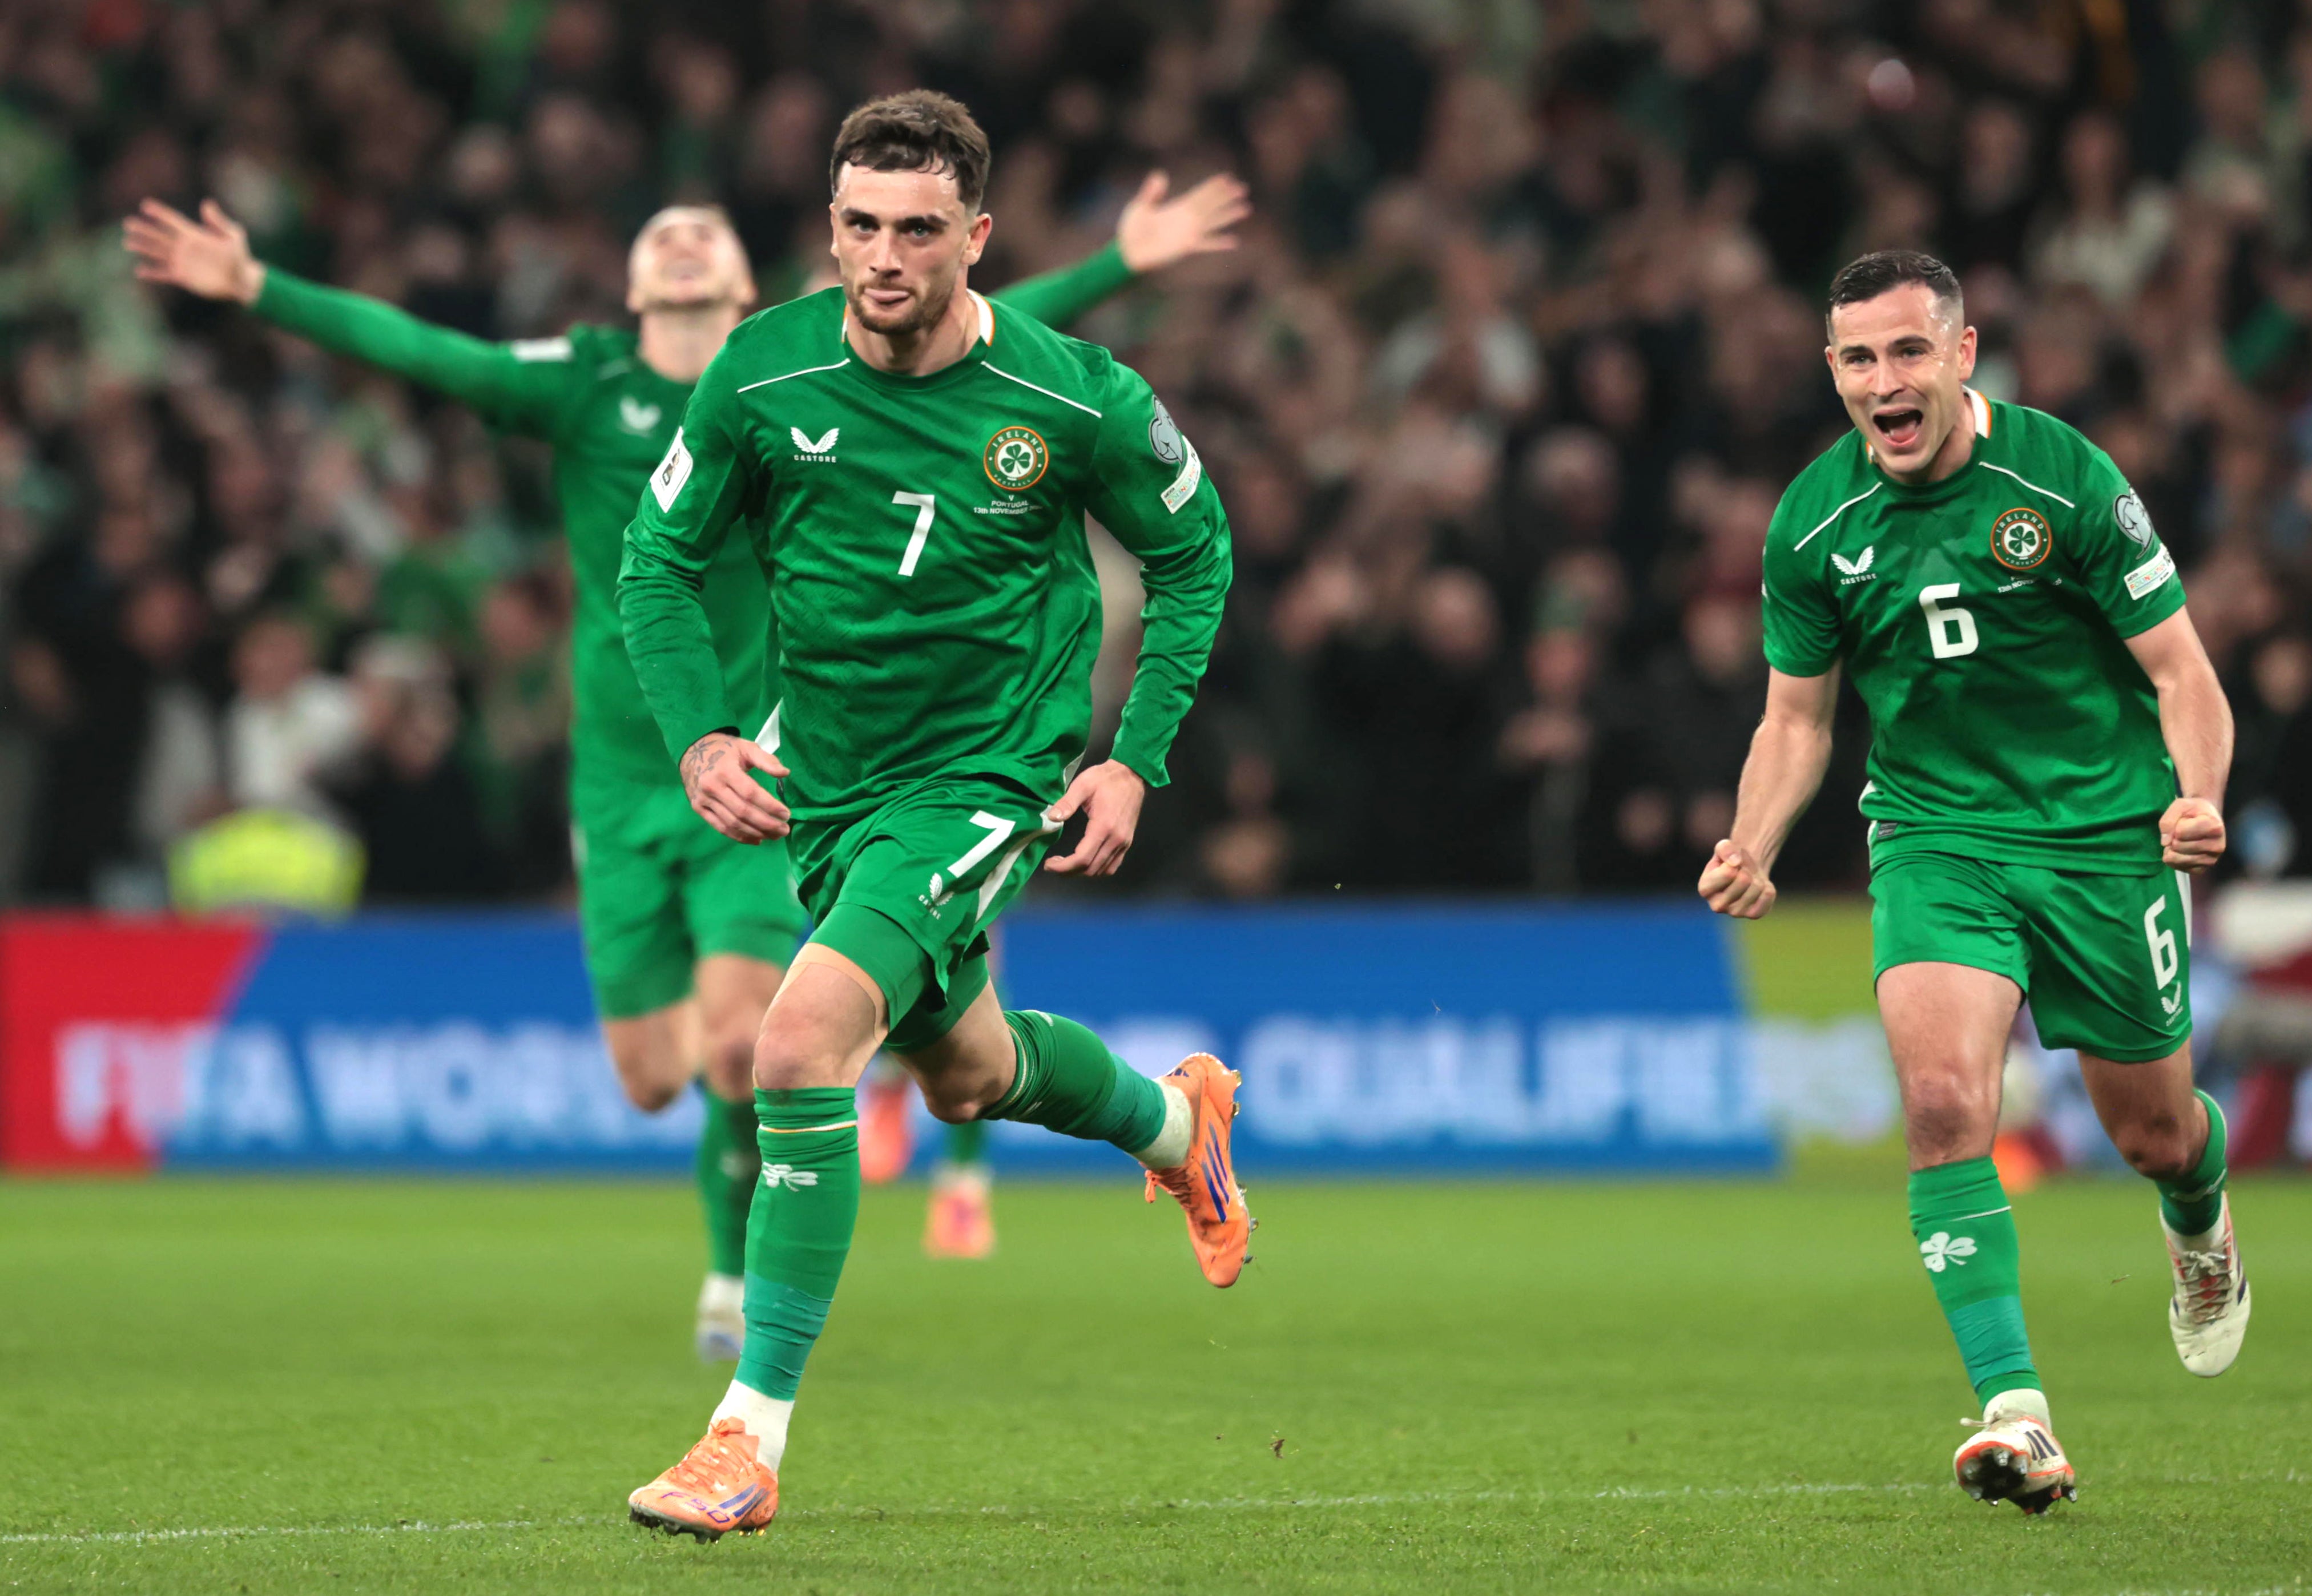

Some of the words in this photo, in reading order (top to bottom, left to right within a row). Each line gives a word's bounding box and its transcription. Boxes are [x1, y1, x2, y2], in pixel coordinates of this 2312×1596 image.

[992, 430, 1043, 454] IRELAND
[892, 490, 935, 577] 7
[1996, 513, 2044, 533] IRELAND
[1840, 573, 1877, 585] CASTORE
[1919, 583, 1979, 659] 6
[947, 810, 1016, 878] 7
[2144, 894, 2178, 990] 6
[661, 1492, 730, 1524] F50
